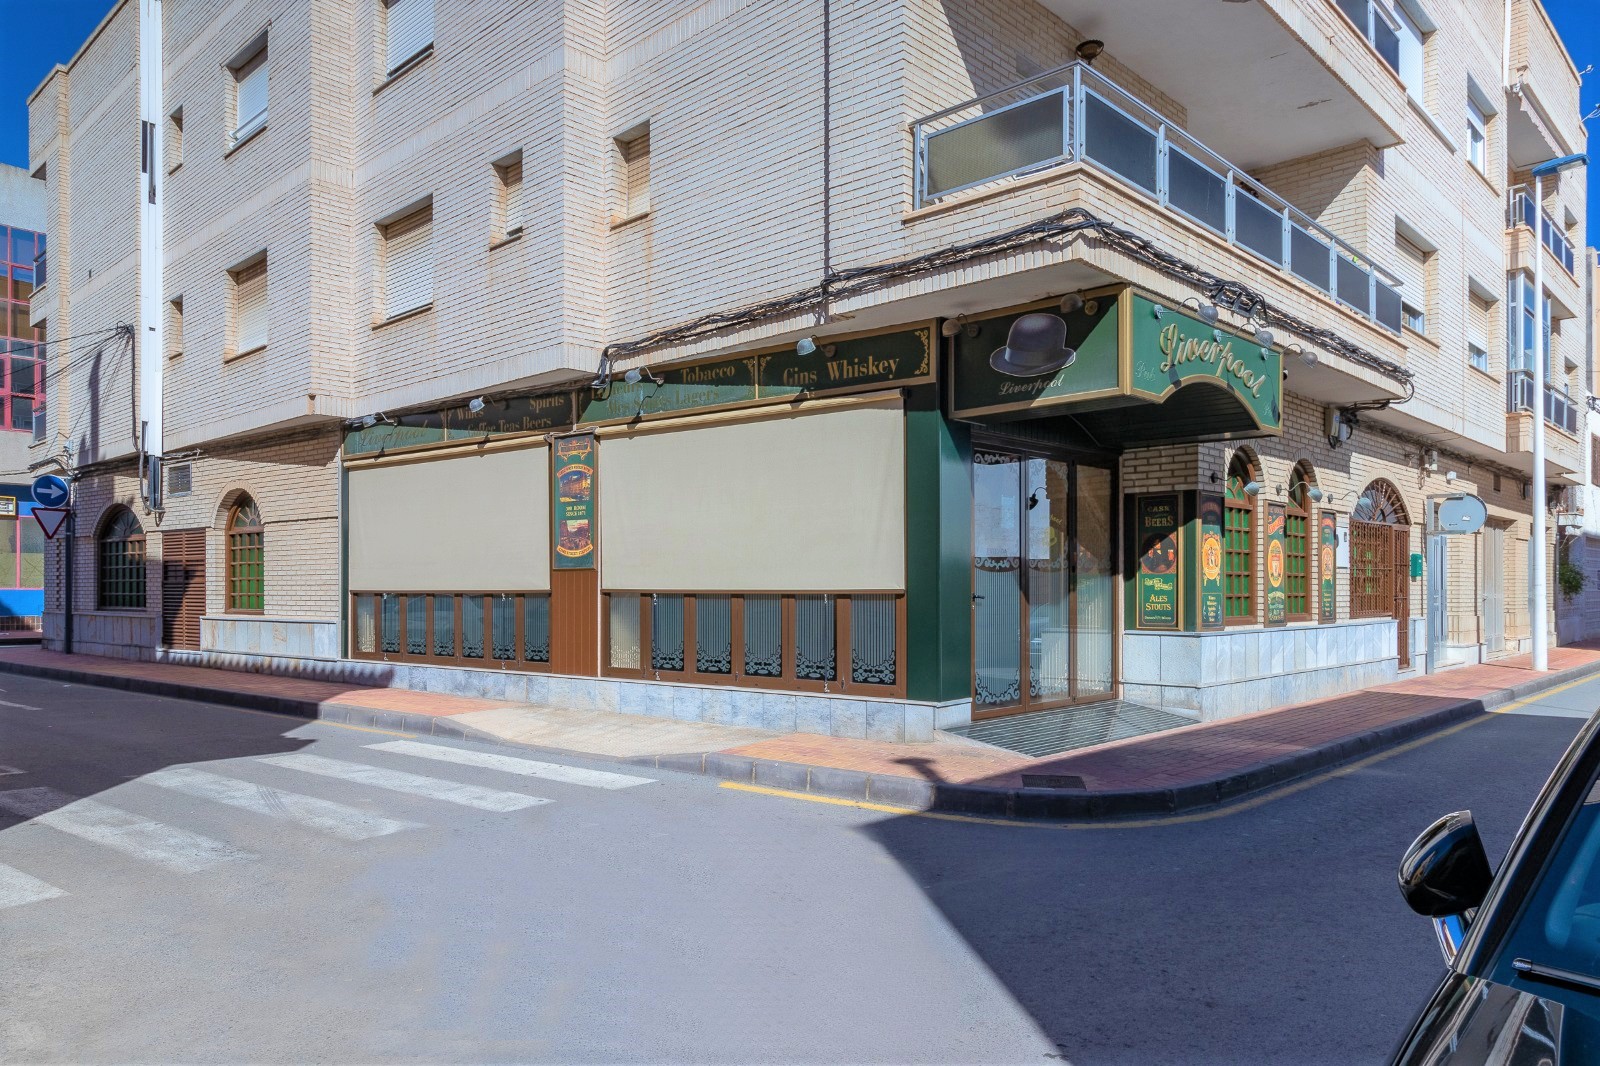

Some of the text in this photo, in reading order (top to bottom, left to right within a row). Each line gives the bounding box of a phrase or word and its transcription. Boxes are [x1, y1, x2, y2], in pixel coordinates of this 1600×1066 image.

[1159, 322, 1266, 400] Liverpool
[680, 365, 735, 384] Tobacco
[783, 356, 900, 387] Gins Whiskey
[998, 374, 1065, 397] Liverpool
[675, 389, 720, 405] Lagers
[456, 395, 565, 420] Wines Spirits
[498, 419, 520, 432] Teas
[522, 416, 552, 430] Beers
[1144, 515, 1174, 528] BEERS
[1149, 593, 1168, 602] ALES
[1145, 602, 1172, 611] STOUTS
